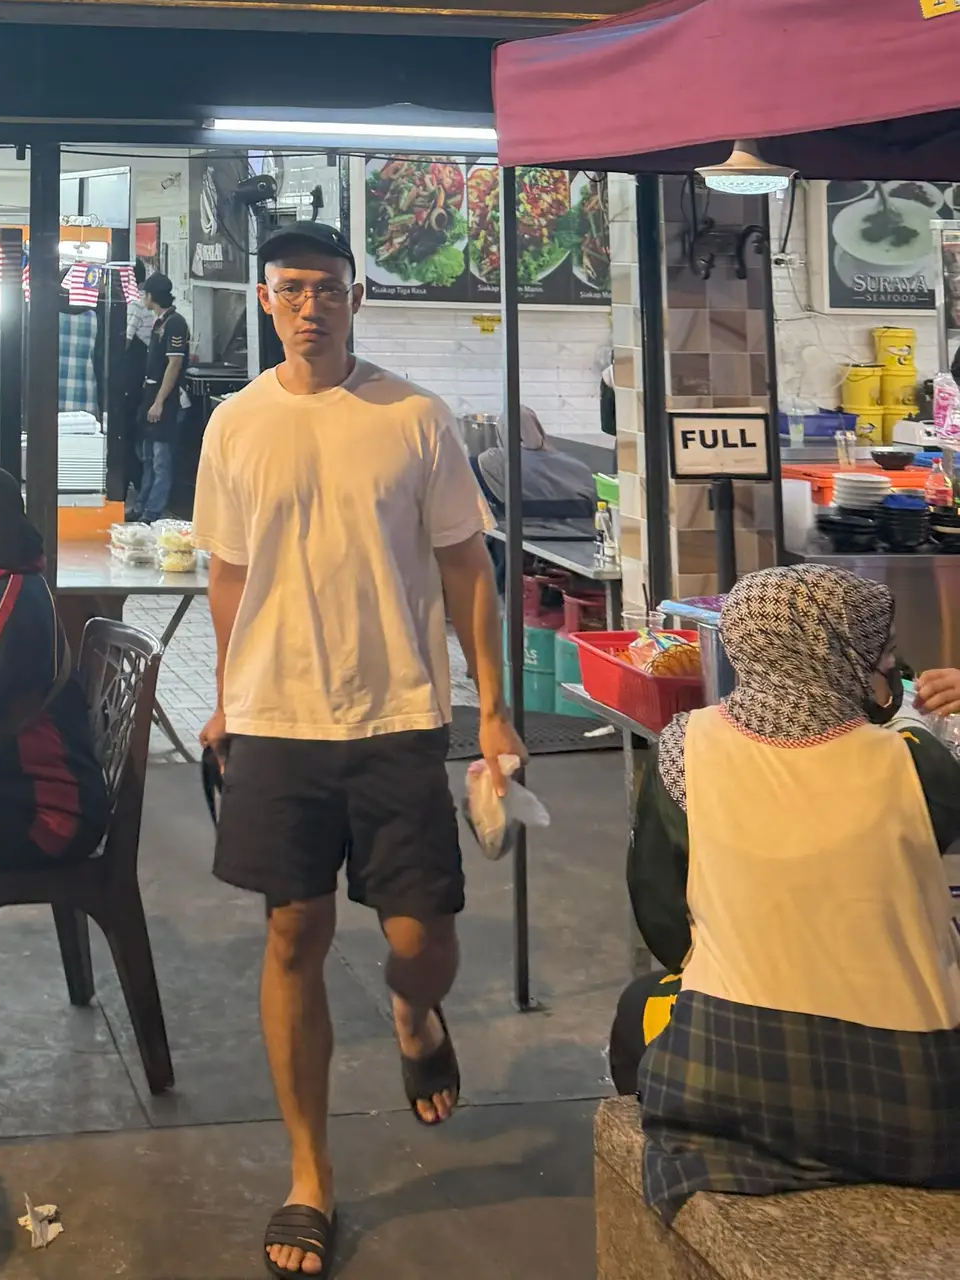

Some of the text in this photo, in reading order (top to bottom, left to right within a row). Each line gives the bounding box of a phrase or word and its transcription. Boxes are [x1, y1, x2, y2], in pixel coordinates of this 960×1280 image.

[852, 273, 929, 293] SURAYA
[411, 286, 427, 295] Rasa
[477, 284, 500, 293] Siakap
[866, 293, 917, 302] SEAFOOD
[680, 428, 757, 450] FULL
